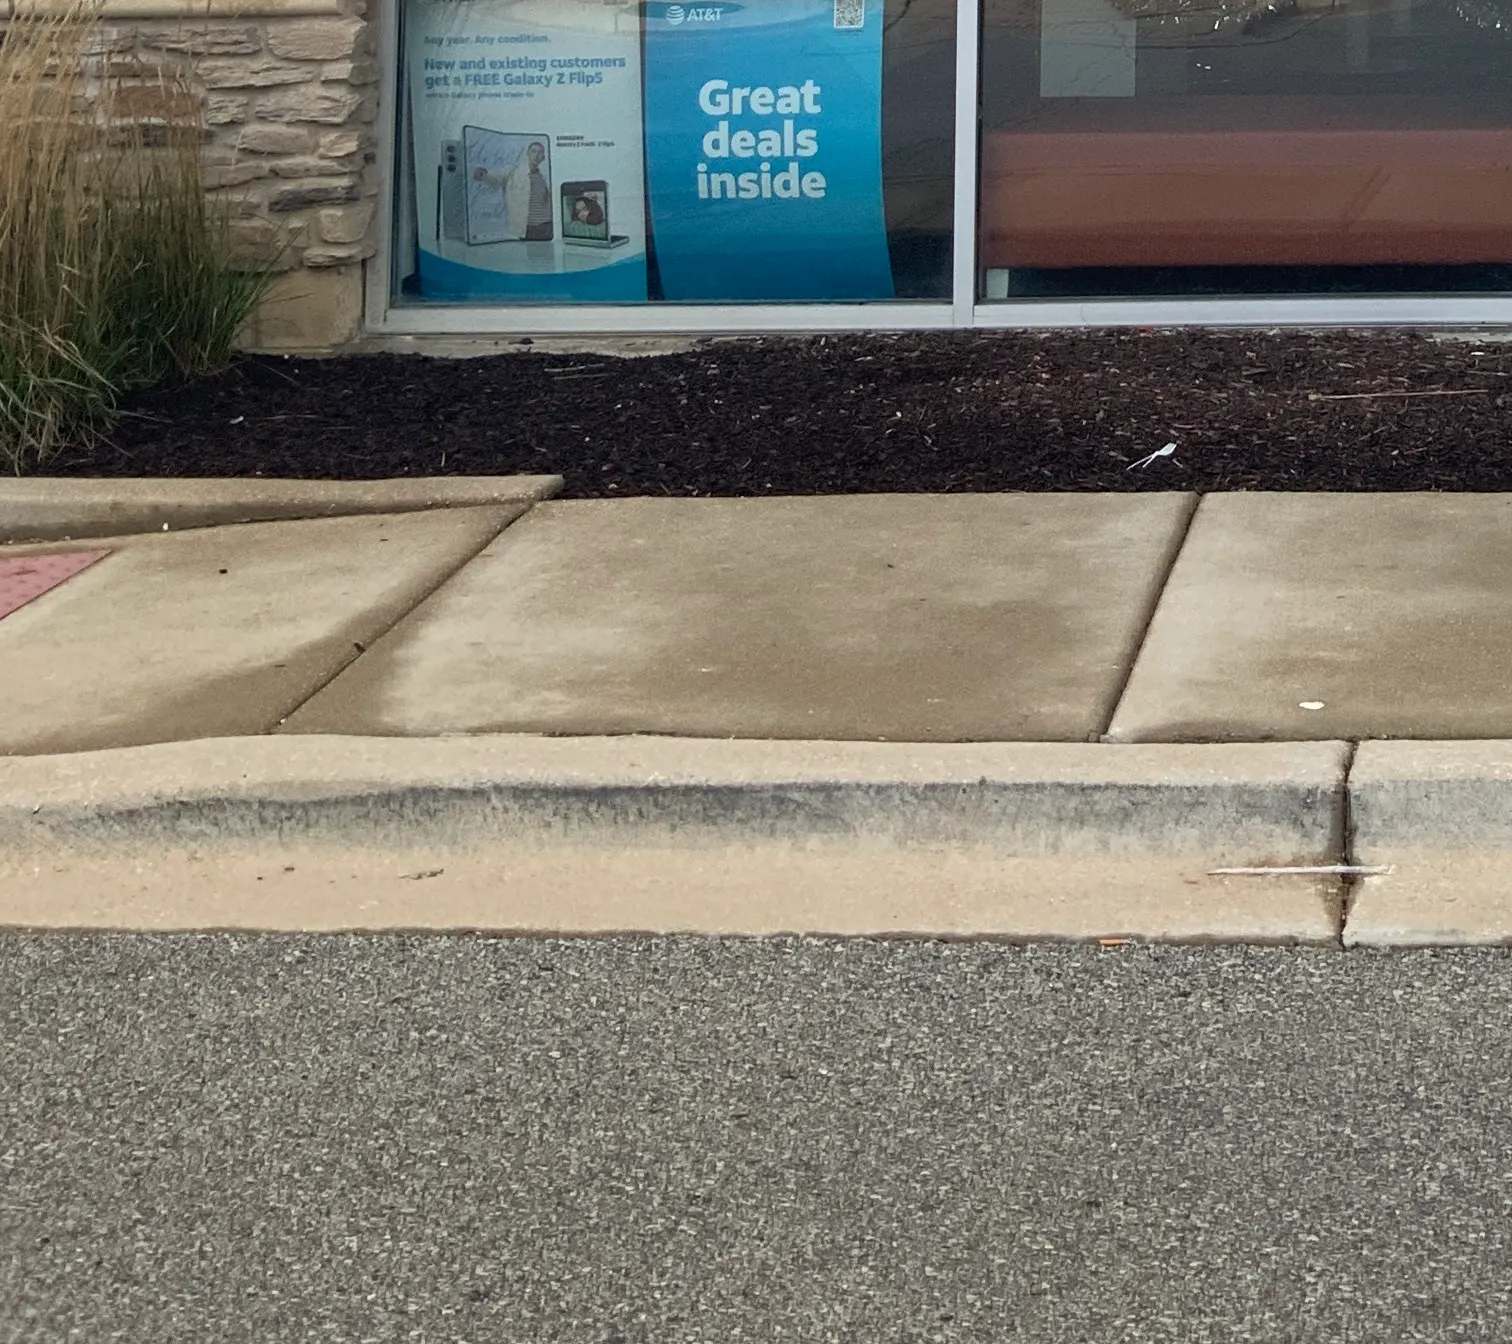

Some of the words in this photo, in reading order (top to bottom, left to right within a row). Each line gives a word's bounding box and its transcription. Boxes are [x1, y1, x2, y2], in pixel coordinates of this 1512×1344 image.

[686, 7, 724, 22] AT&T
[474, 34, 495, 46] Any
[424, 57, 455, 71] New
[459, 56, 486, 70] and
[489, 55, 547, 72] existing
[549, 56, 627, 69] customers
[425, 74, 449, 90] get
[453, 76, 461, 86] a
[464, 73, 500, 86] FREE
[503, 72, 553, 88] Galaxy
[556, 72, 566, 85] Z
[699, 79, 822, 116] Great
[702, 119, 819, 158] deals
[697, 161, 827, 200] inside
